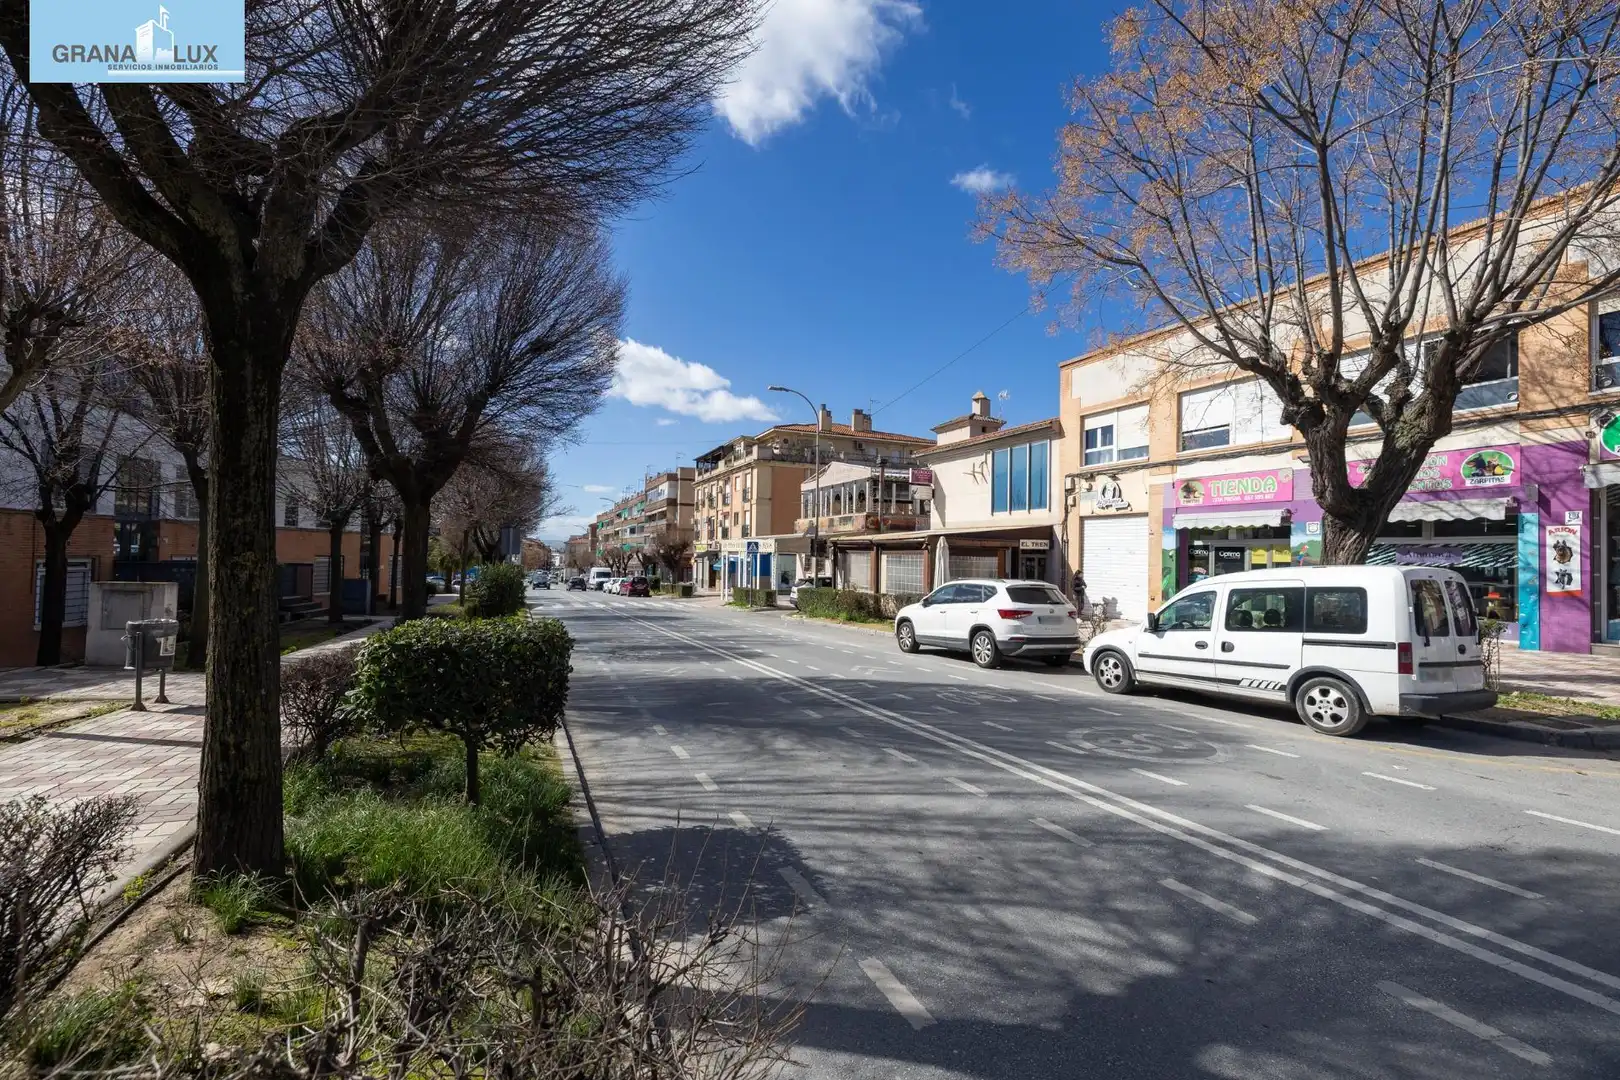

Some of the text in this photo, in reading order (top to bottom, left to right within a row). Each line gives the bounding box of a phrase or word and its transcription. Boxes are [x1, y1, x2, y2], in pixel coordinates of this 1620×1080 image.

[1470, 477, 1505, 485] ZARPITAS
[1210, 475, 1277, 498] TIENDA
[1548, 526, 1577, 536] ARION
